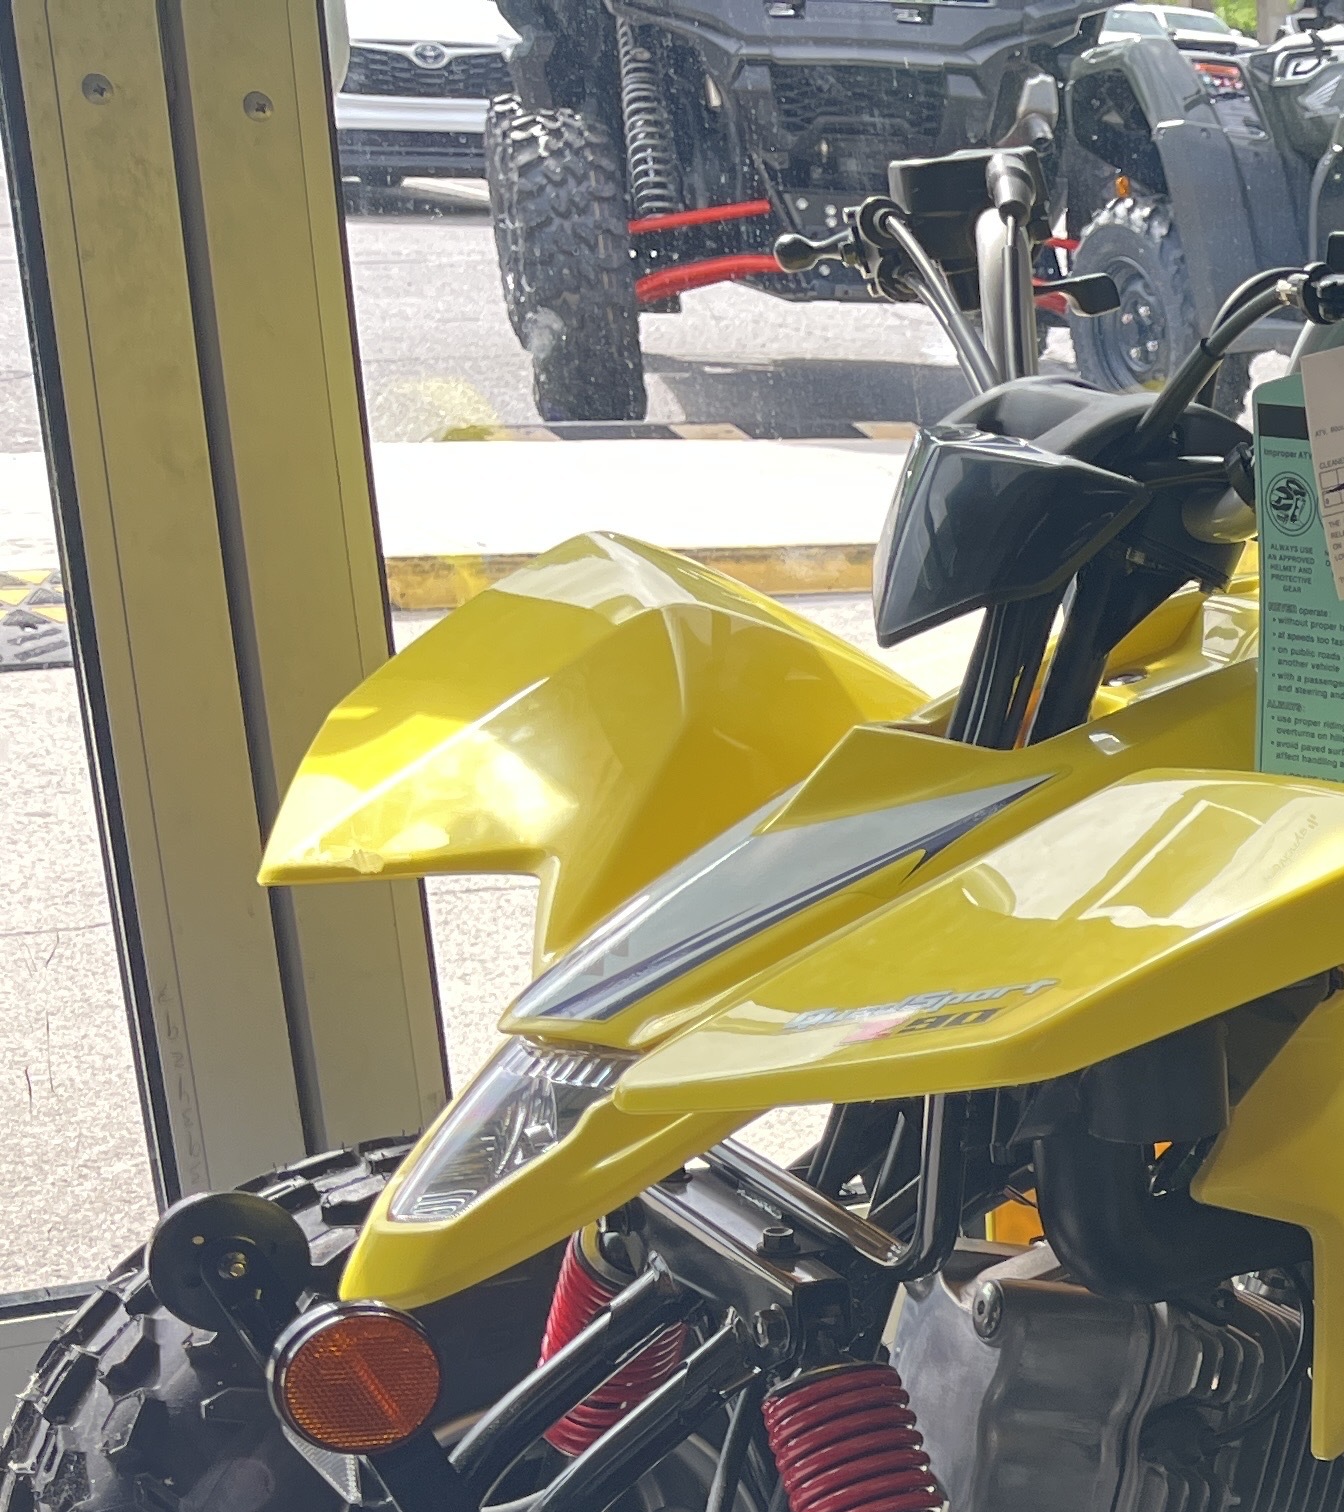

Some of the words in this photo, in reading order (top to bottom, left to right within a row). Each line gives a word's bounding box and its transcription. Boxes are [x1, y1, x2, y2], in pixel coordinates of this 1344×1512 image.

[1271, 544, 1298, 553] ALWAYS
[1279, 555, 1315, 565] APPROVED
[1270, 564, 1296, 573] HELMET
[1298, 567, 1312, 575] AND
[1271, 574, 1312, 584] PROTECTIVE
[1283, 585, 1301, 593] GEAR
[1311, 621, 1337, 630] proper
